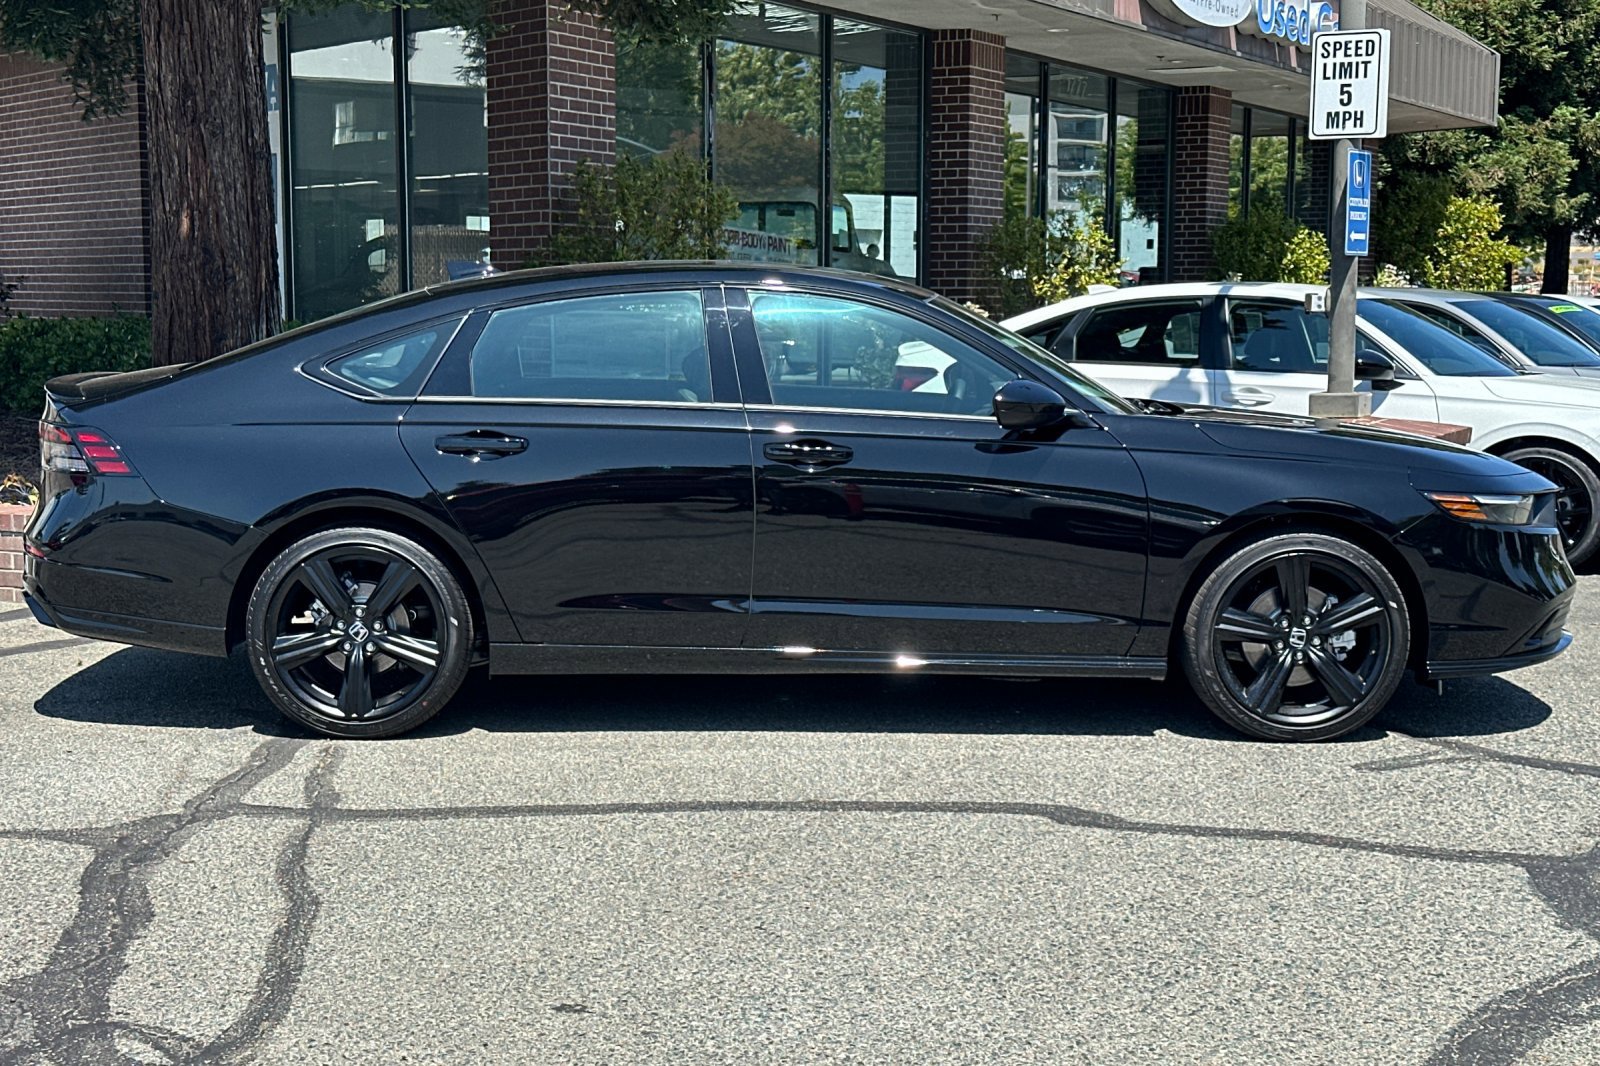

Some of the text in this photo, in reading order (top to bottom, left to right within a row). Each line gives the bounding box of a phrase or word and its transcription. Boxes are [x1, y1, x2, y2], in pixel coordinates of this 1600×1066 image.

[1257, 0, 1310, 45] Used
[1321, 39, 1375, 59] SPEED
[1322, 60, 1372, 80] LIMIT
[1339, 83, 1353, 107] 5
[1325, 110, 1364, 131] MPH
[767, 235, 792, 255] PAINT
